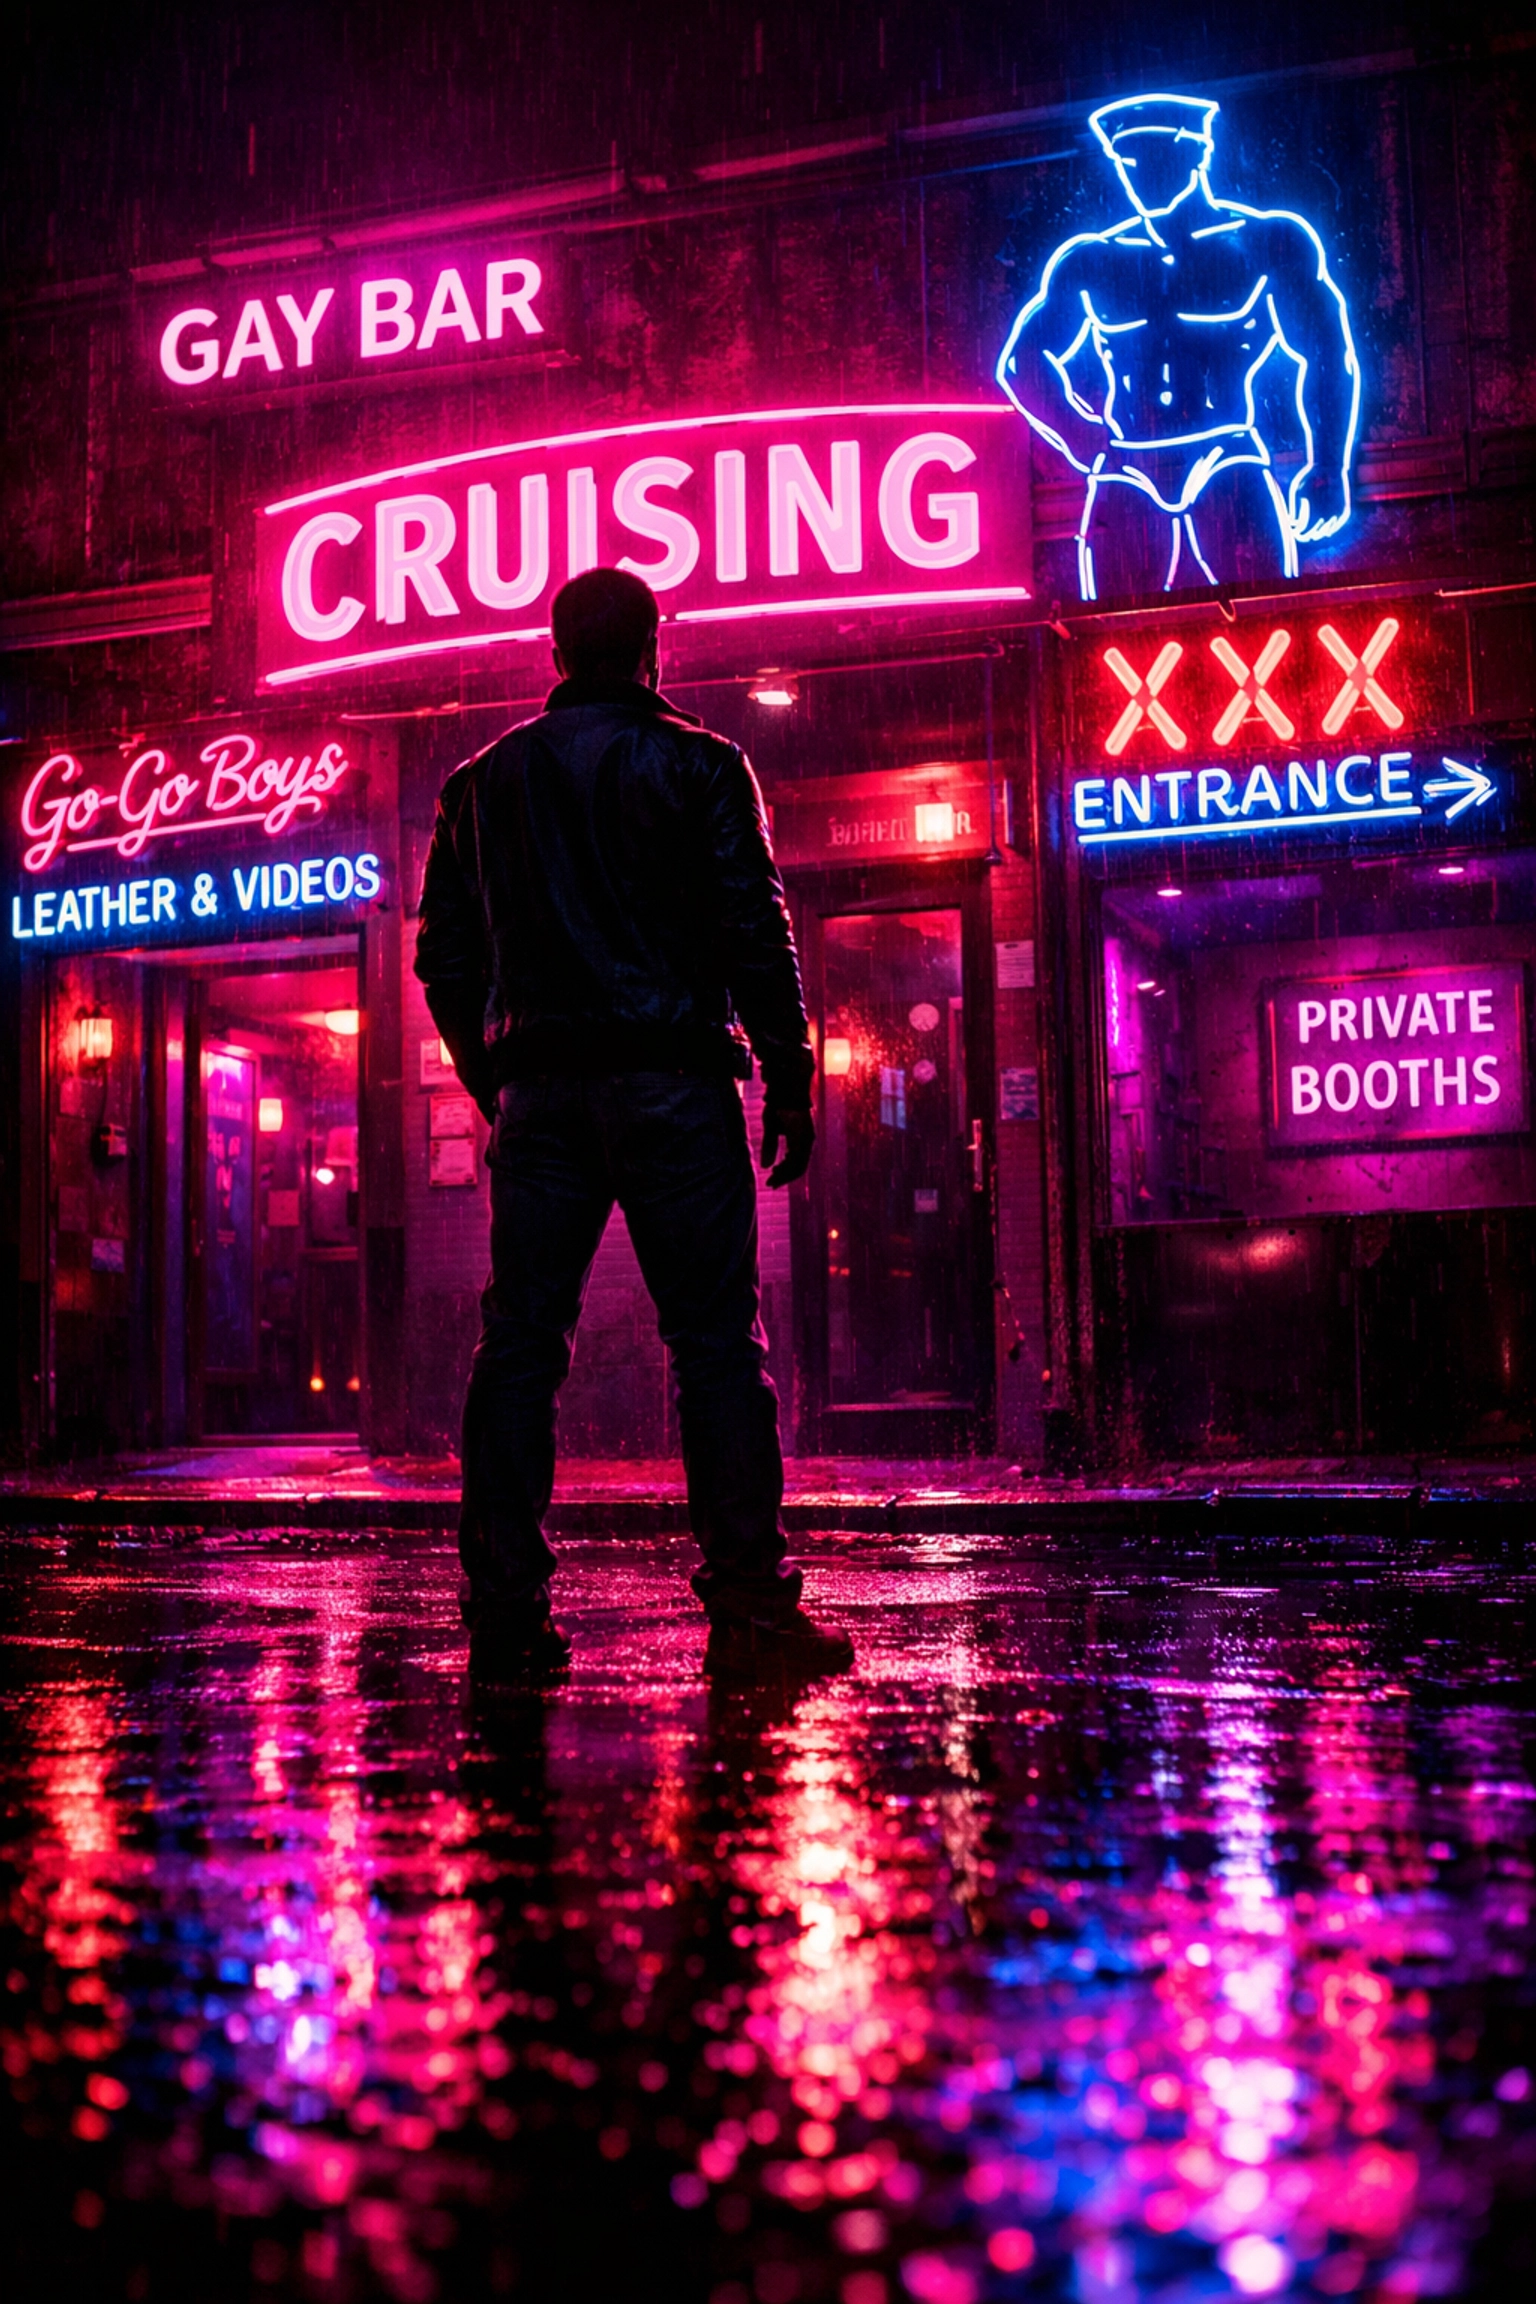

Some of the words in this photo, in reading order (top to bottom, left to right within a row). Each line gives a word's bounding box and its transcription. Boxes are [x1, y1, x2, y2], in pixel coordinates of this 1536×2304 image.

[160, 287, 335, 385] GAY
[360, 258, 544, 358] BAR
[281, 431, 980, 641] CRUISING
[1103, 617, 1404, 756] XXX
[22, 750, 199, 870] Go-Go
[201, 735, 348, 833] Boys
[1074, 751, 1414, 831] ENTRANCE
[12, 878, 178, 939] LEATHER
[190, 873, 218, 918] &
[233, 854, 380, 911] VIDEOS
[1298, 990, 1495, 1044] PRIVATE
[1291, 1055, 1500, 1114] BOOTHS
